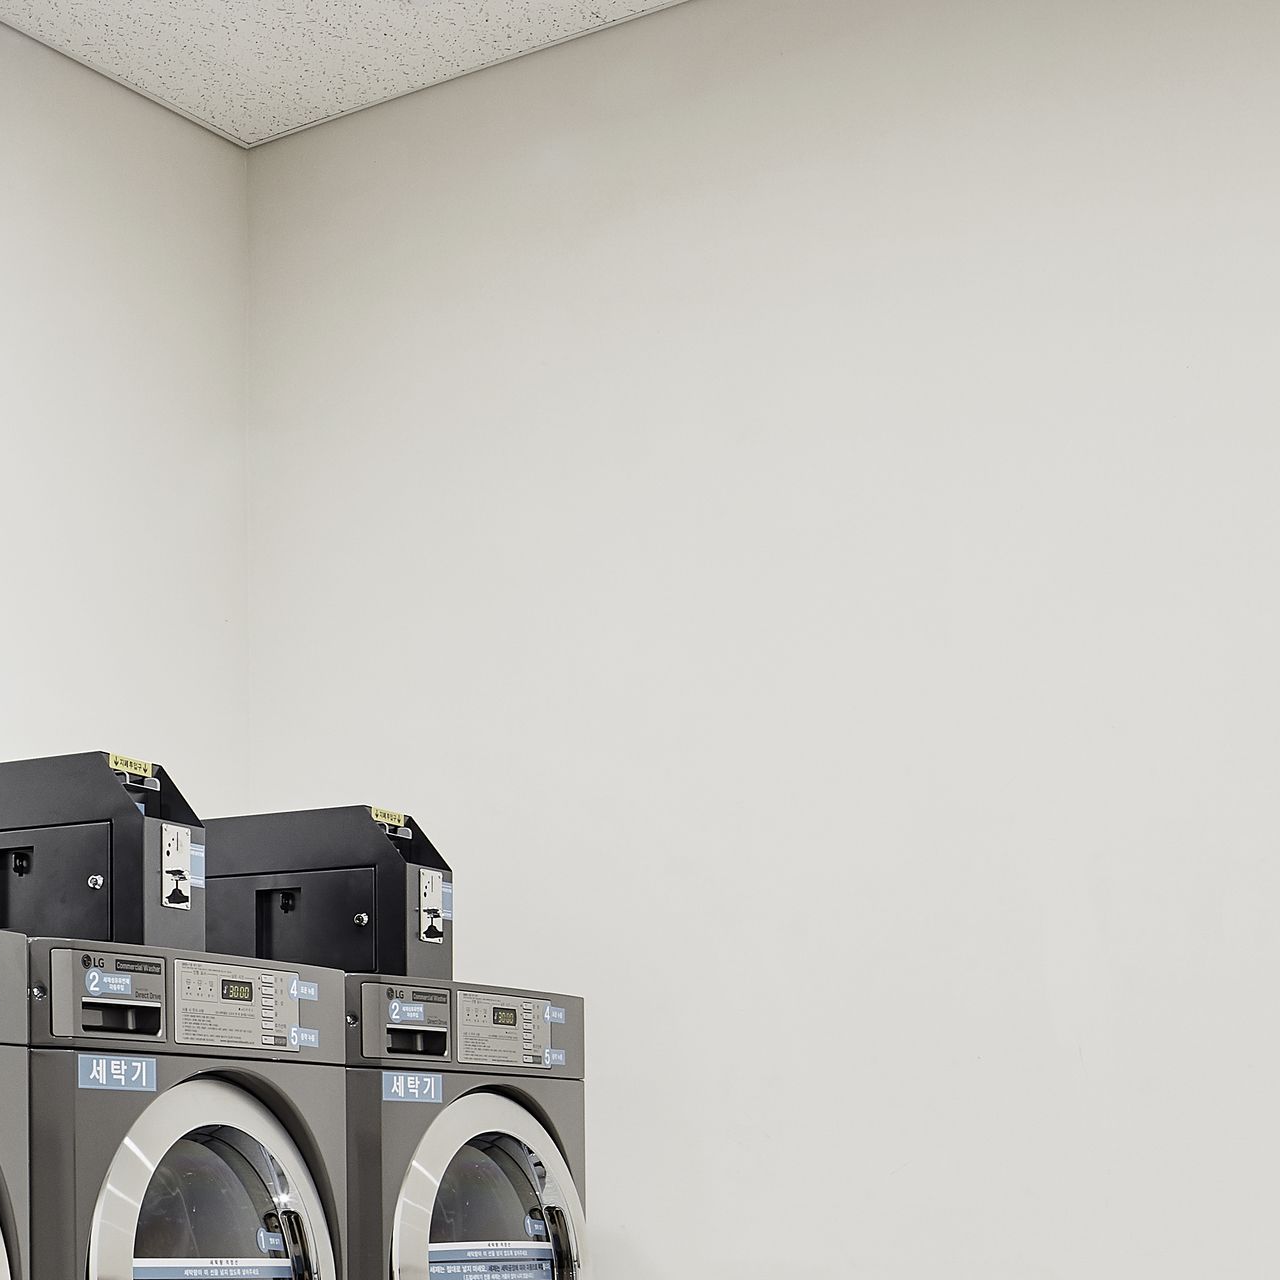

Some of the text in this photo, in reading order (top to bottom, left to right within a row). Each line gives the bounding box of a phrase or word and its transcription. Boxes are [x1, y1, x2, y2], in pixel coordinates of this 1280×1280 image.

[93, 957, 105, 968] LG
[89, 972, 100, 992] 2
[290, 981, 297, 997] 4
[391, 1002, 400, 1018] 2
[544, 1005, 551, 1020] 4
[291, 1028, 298, 1045] 5
[544, 1051, 551, 1065] 5
[89, 1058, 147, 1087] 세탁기
[391, 1076, 435, 1098] 세탁기
